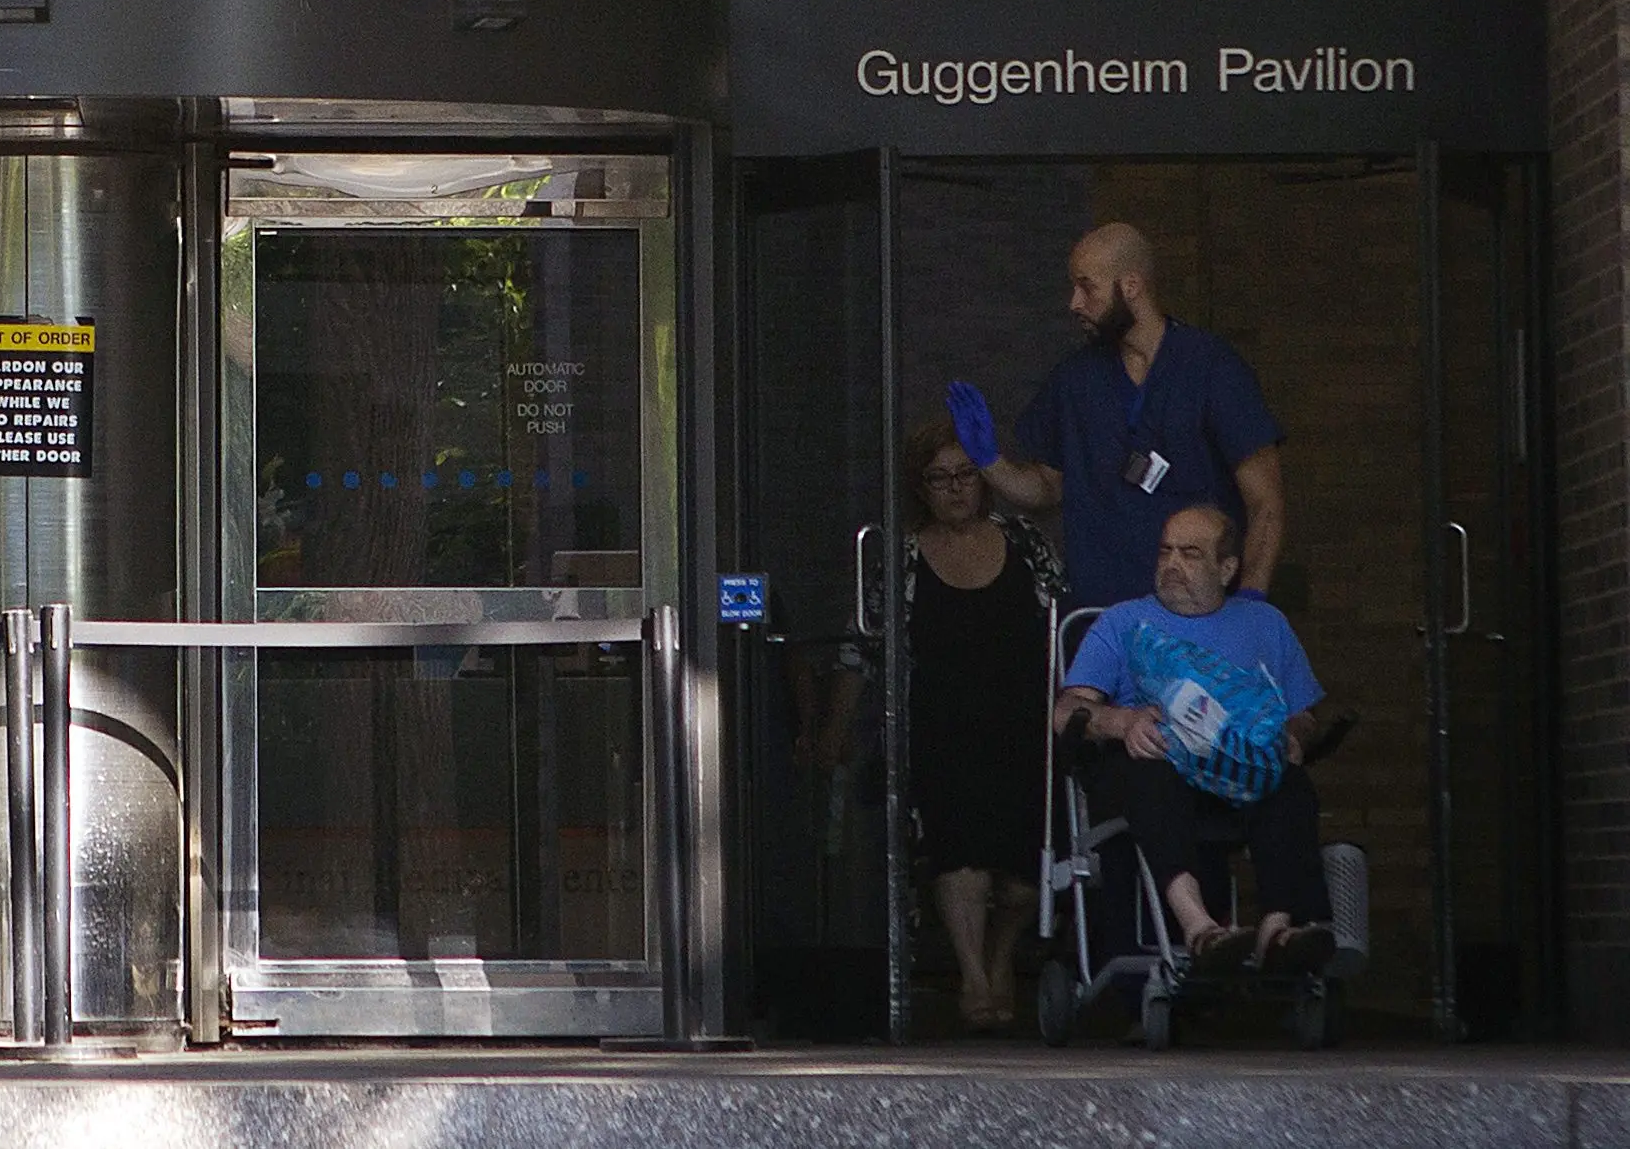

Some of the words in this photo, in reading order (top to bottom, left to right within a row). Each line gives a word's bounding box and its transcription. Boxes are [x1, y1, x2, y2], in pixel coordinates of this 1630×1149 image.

[856, 49, 1188, 105] Guggenheim
[1218, 47, 1415, 93] Pavilion
[11, 331, 32, 345] OF
[38, 331, 91, 346] ORDER
[51, 361, 84, 374] OUR
[507, 362, 585, 376] AUTOMATIC
[524, 380, 567, 393] DOOR
[47, 397, 70, 410] WE
[517, 404, 539, 417] DO
[544, 404, 575, 417] NOT
[13, 414, 78, 427] REPAIRS
[527, 421, 566, 434] PUSH
[47, 432, 75, 445] USE
[36, 450, 81, 463] DOOR
